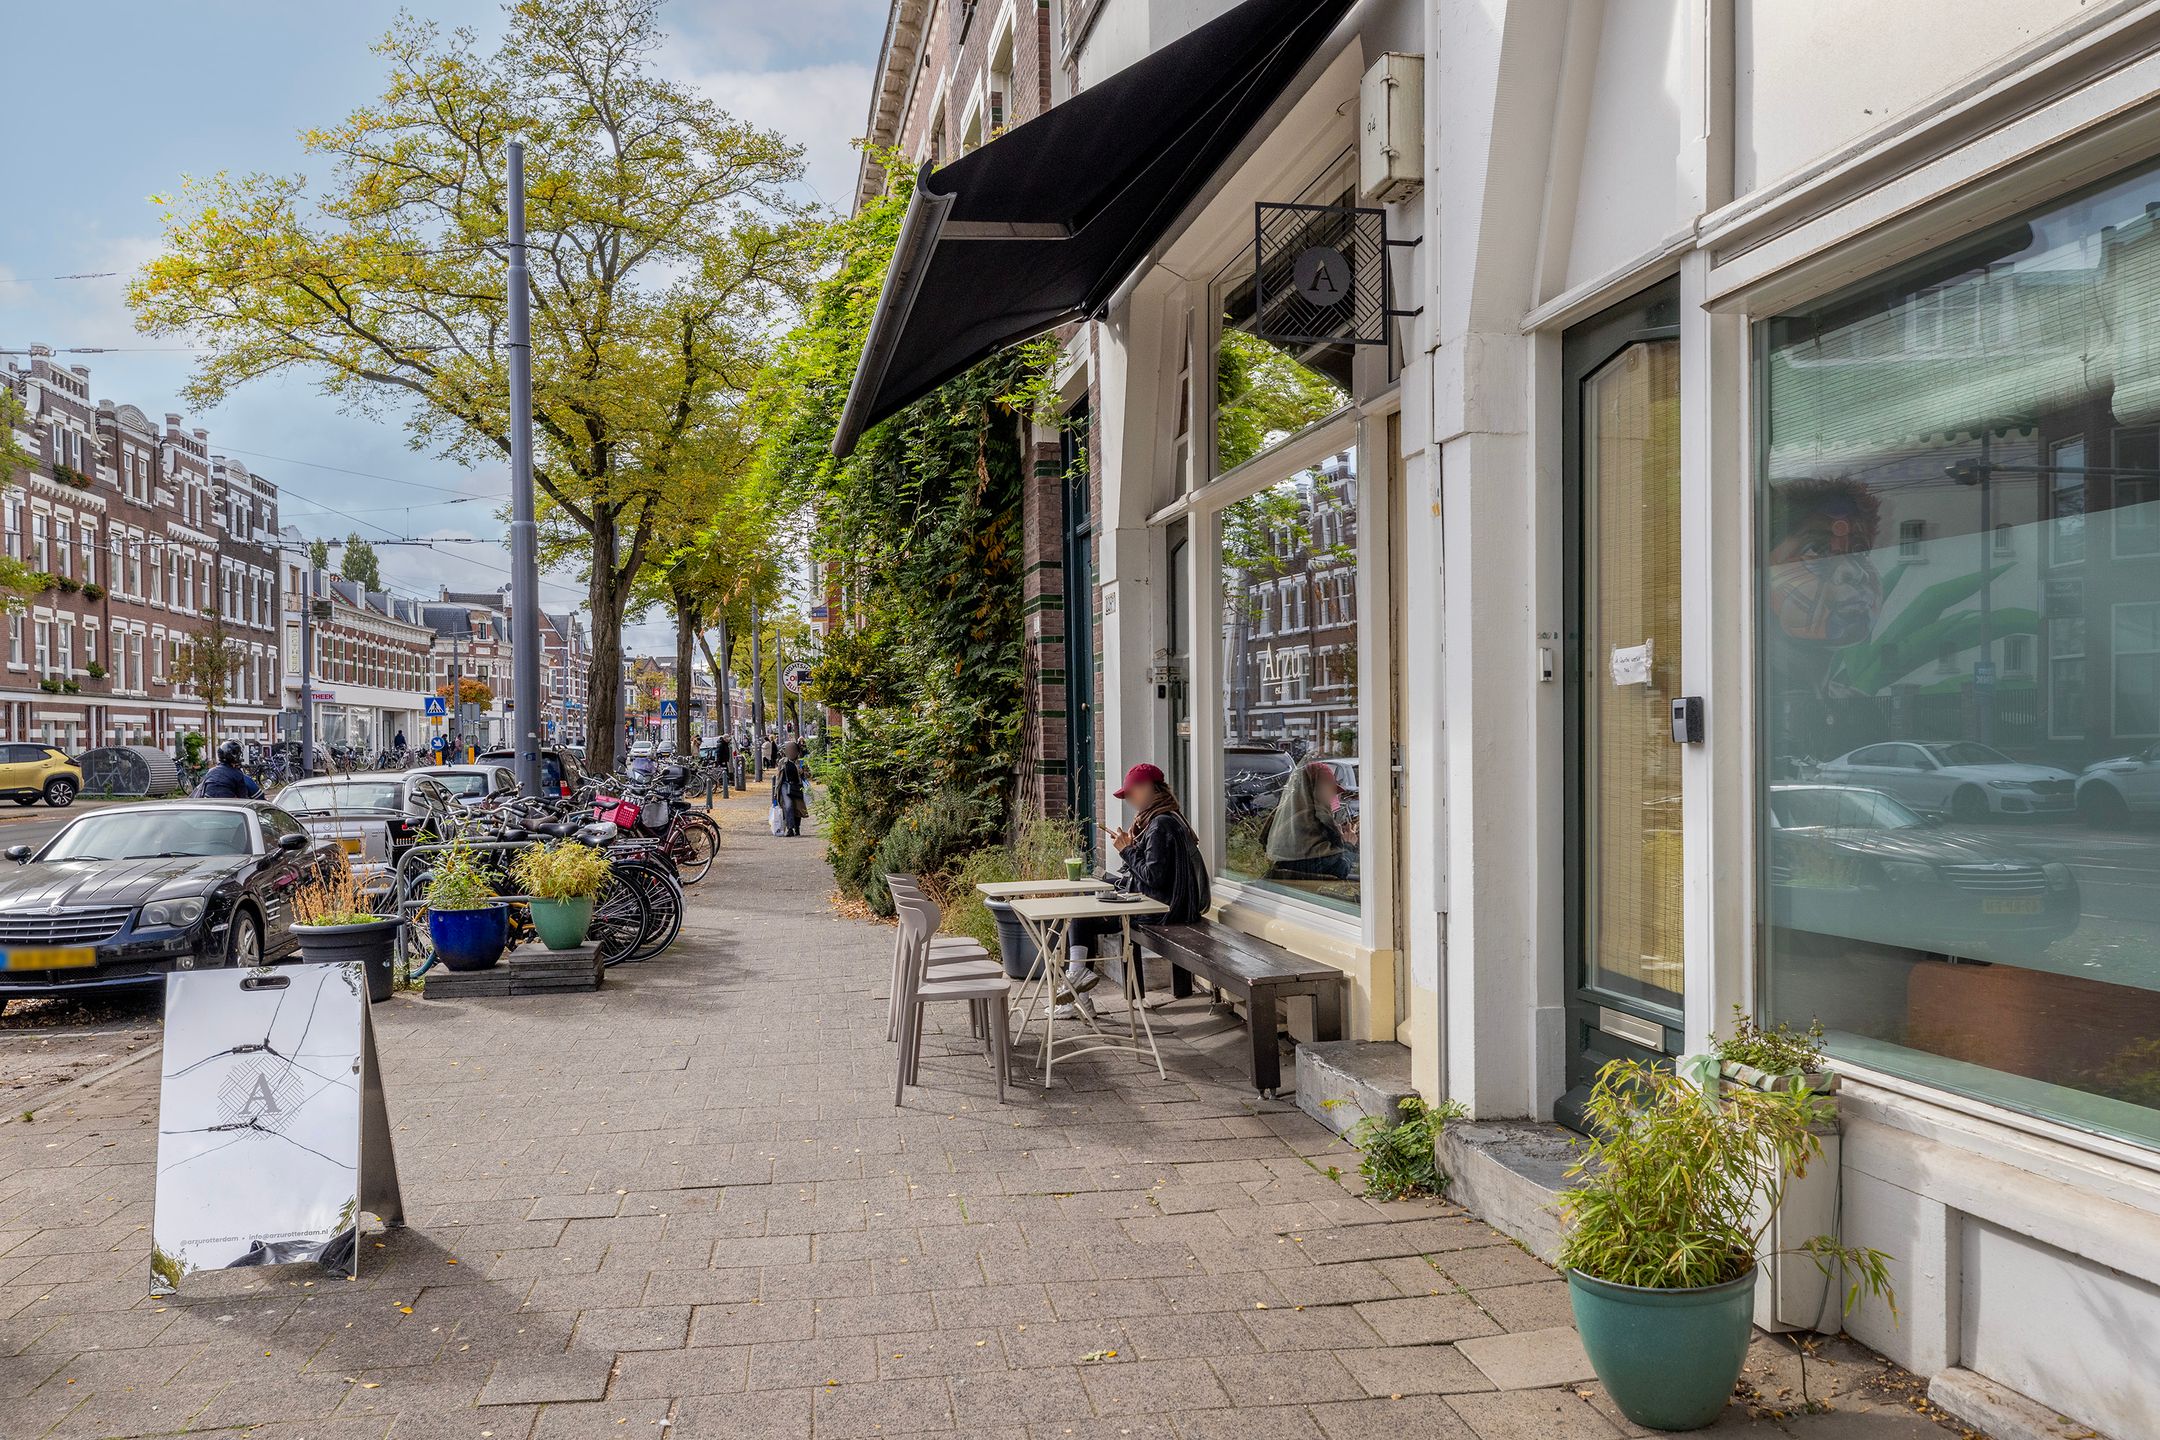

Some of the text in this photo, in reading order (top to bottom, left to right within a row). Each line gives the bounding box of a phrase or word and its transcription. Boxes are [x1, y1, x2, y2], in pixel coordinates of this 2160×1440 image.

[1307, 259, 1338, 292] A
[1263, 641, 1300, 680] Arzu
[239, 1072, 282, 1115] A
[248, 1228, 329, 1240] info@arzurotterdam.nl
